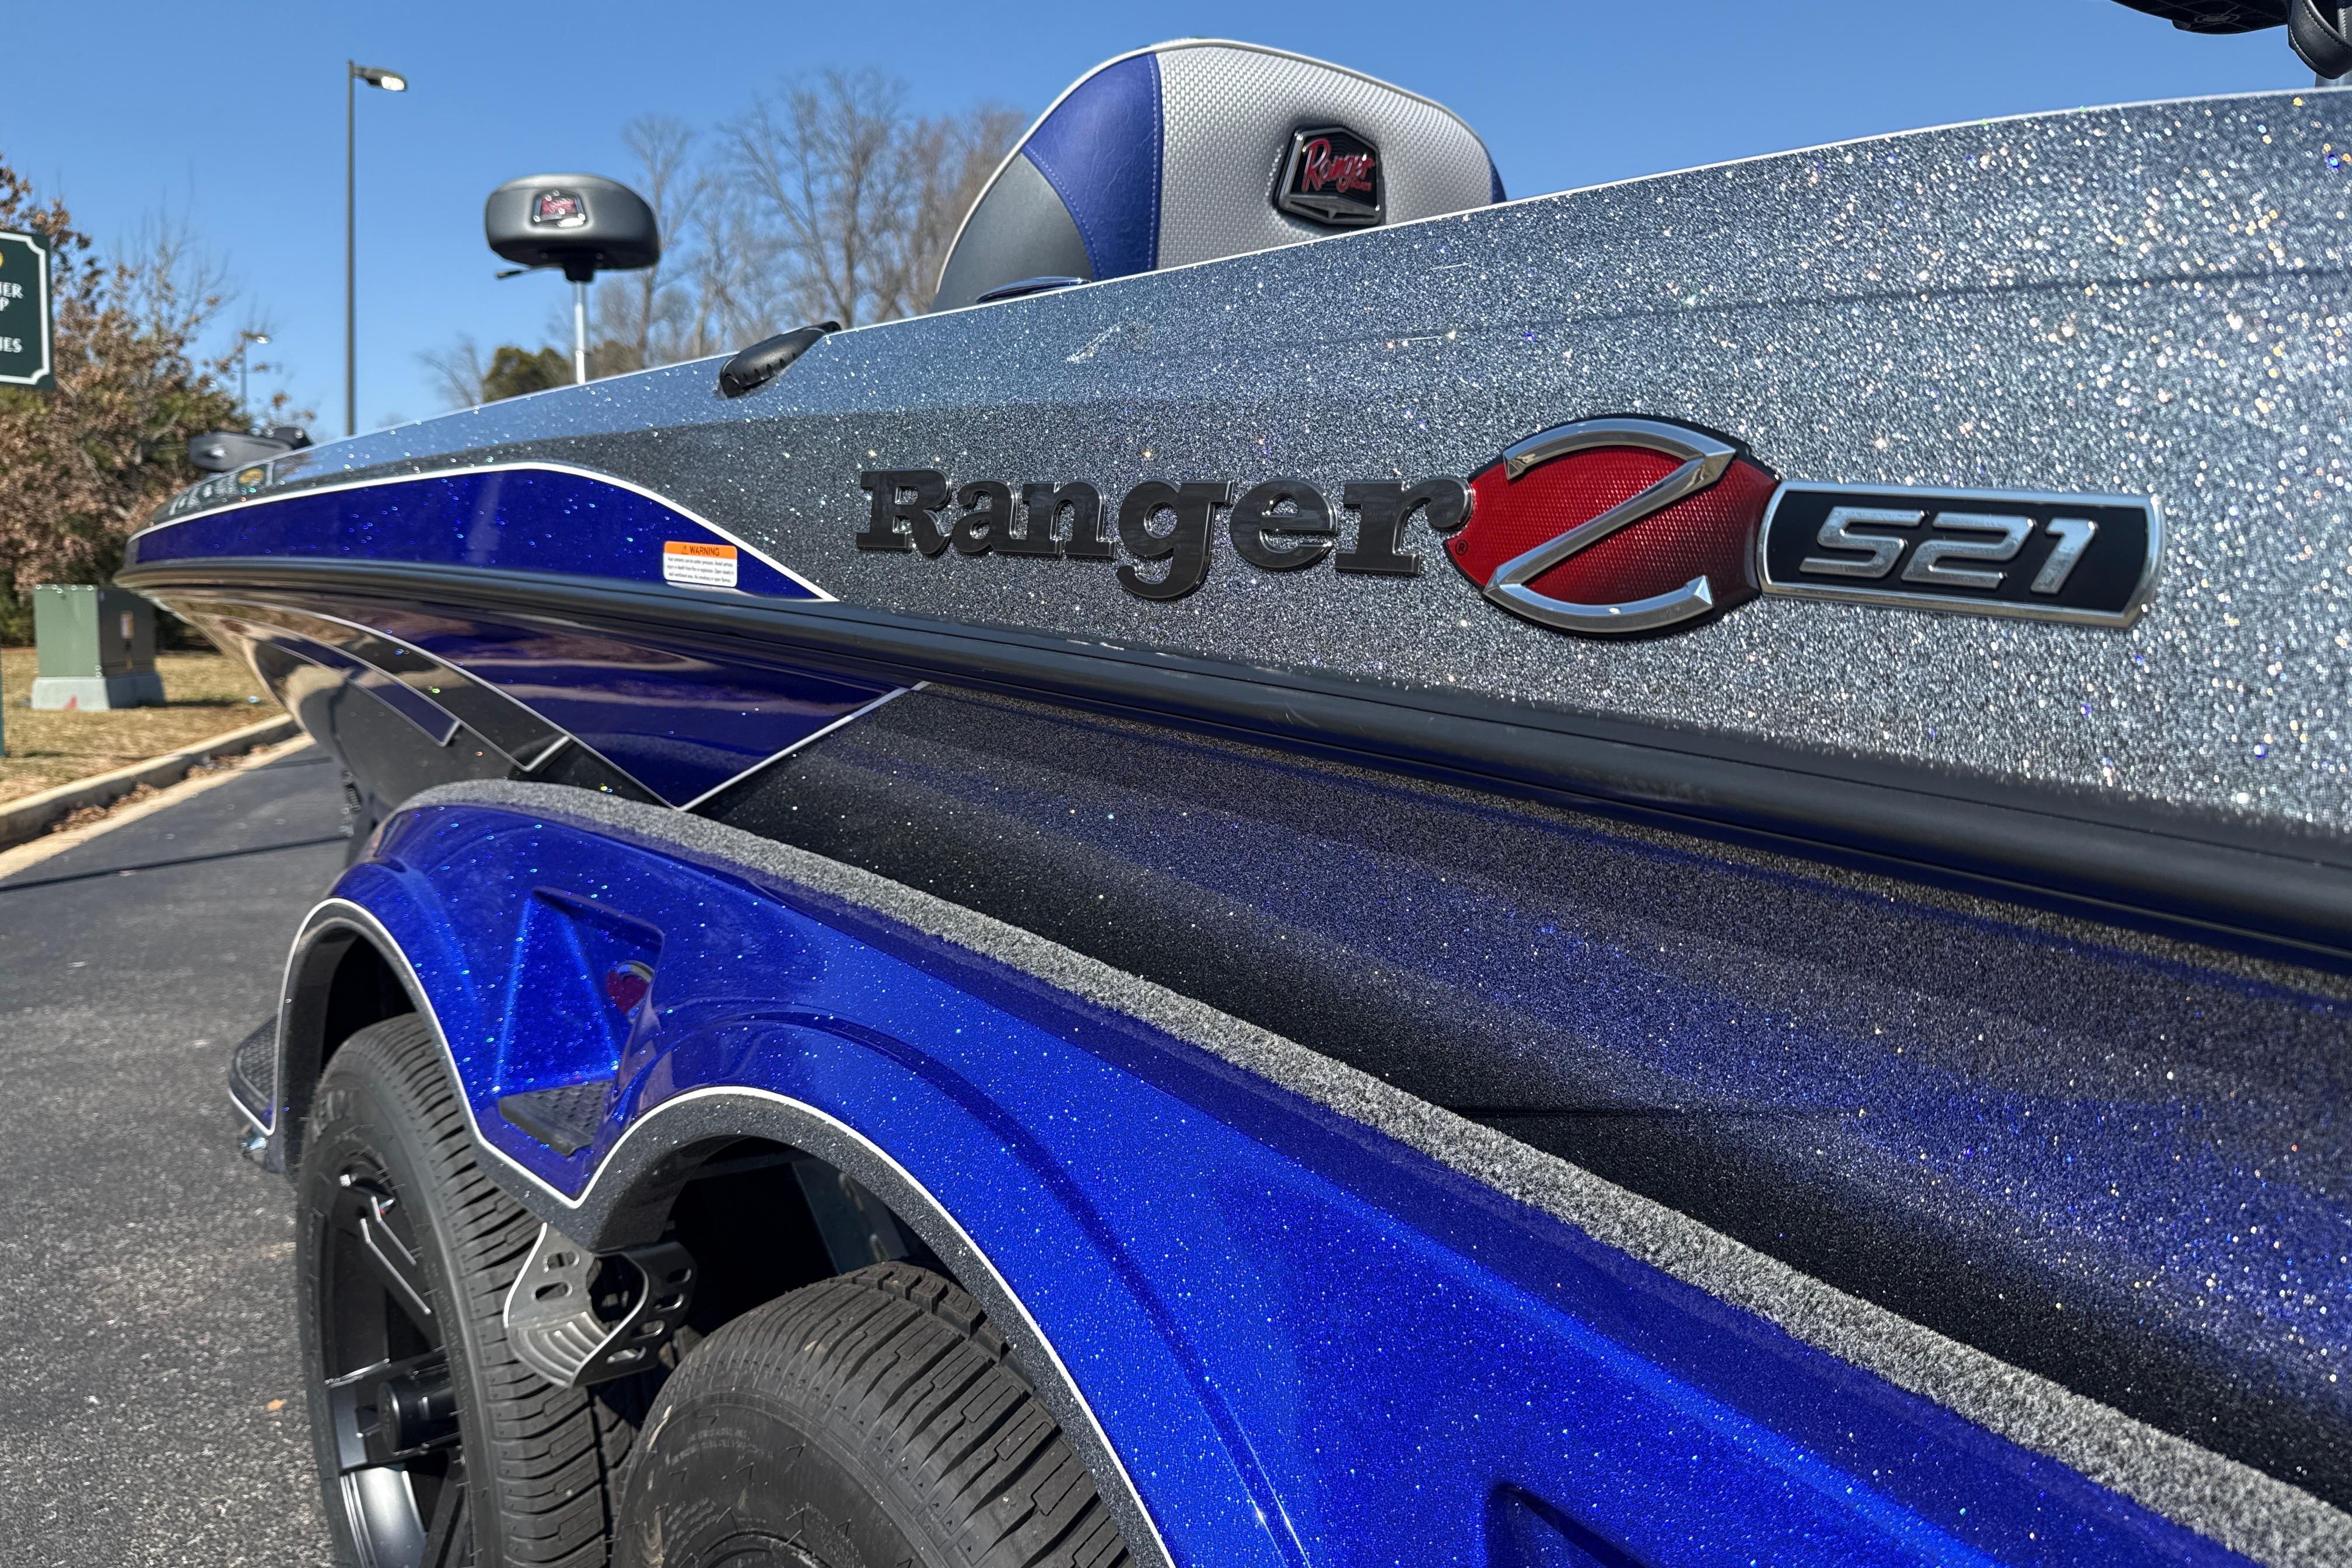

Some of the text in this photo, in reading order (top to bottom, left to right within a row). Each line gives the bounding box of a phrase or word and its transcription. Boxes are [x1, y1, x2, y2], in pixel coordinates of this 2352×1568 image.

[1301, 138, 1376, 192] Ranger
[690, 545, 720, 556] WARNING
[856, 467, 1474, 601] Ranger
